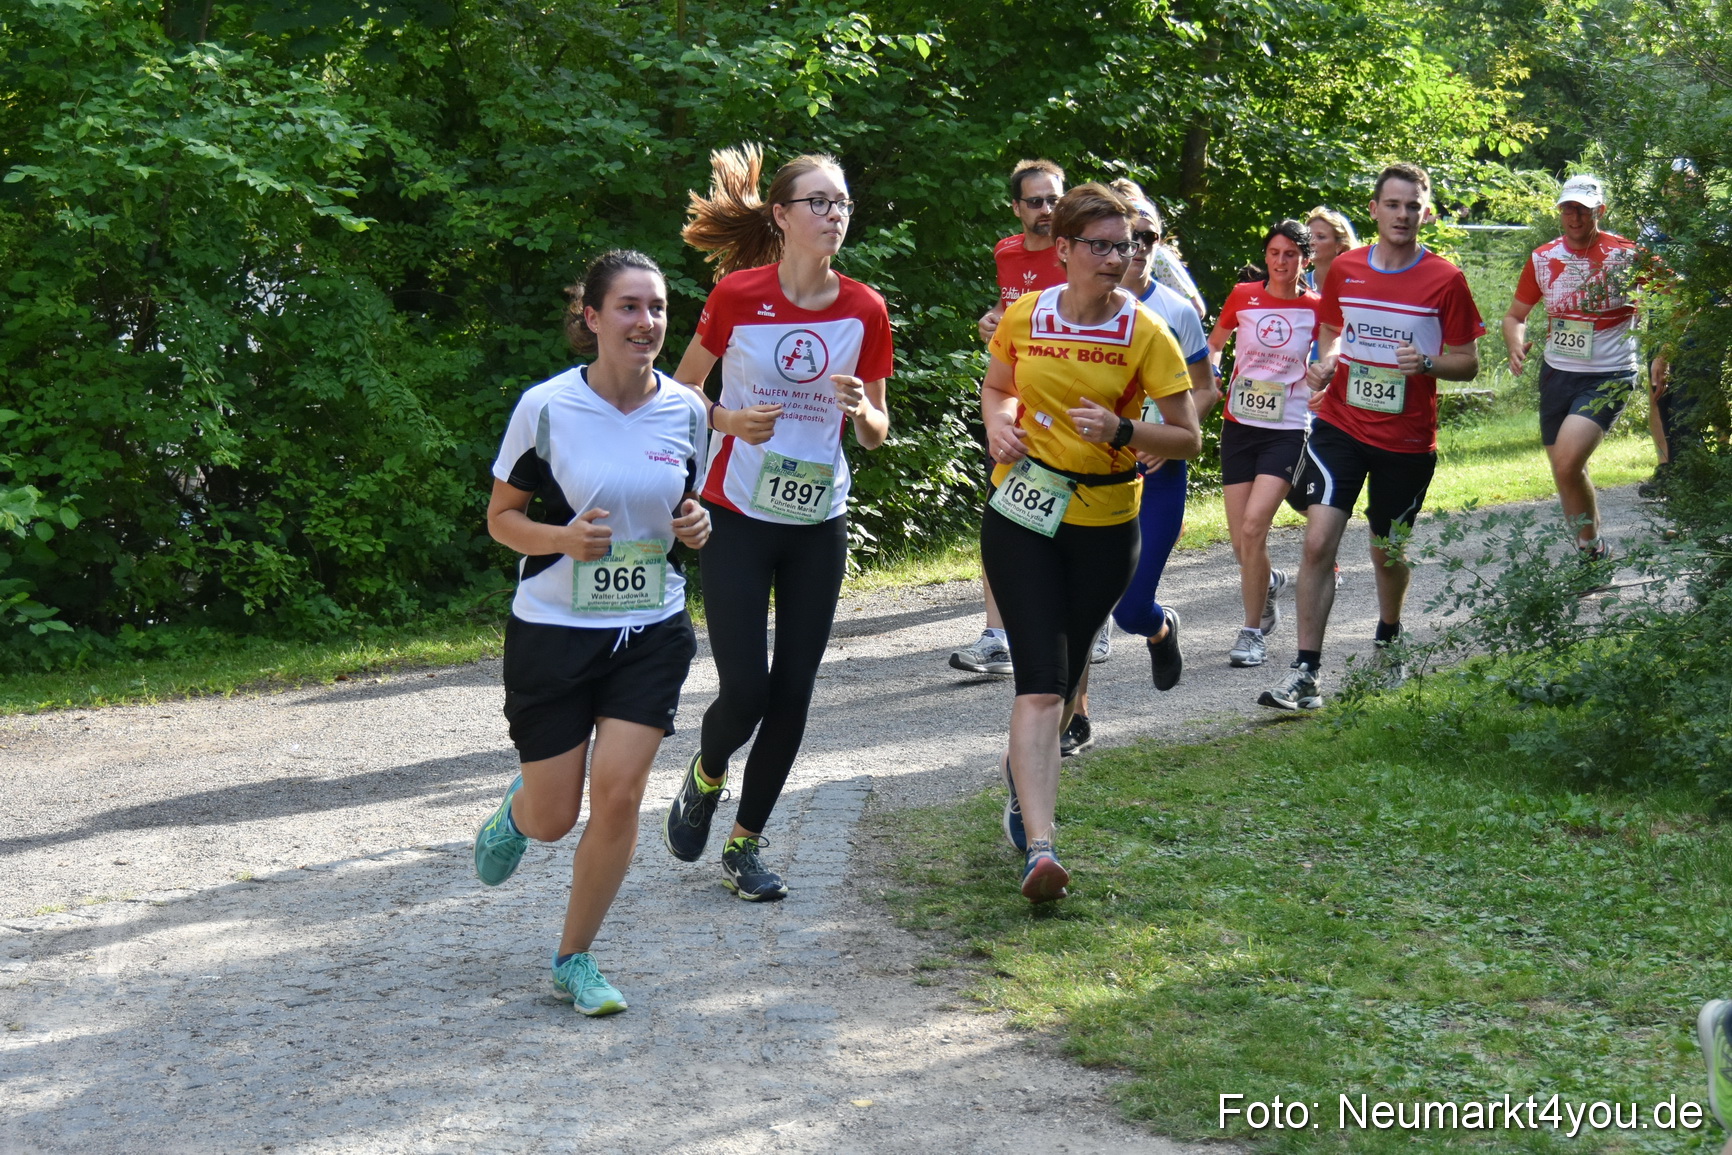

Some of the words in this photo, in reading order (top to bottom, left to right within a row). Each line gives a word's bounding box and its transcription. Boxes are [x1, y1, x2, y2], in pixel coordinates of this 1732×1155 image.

[1358, 322, 1413, 344] Petry
[1554, 331, 1586, 348] 2236
[1028, 345, 1070, 359] MAX
[1077, 347, 1128, 366] BÖGL
[753, 384, 788, 397] LAUFEN
[791, 391, 810, 400] MIT
[1354, 379, 1397, 401] 1834
[792, 402, 802, 410] Dr.
[803, 404, 828, 414] Röschl
[1238, 391, 1277, 411] 1894
[654, 456, 680, 464] partner
[768, 476, 827, 507] 1897
[1004, 476, 1056, 518] 1684
[1026, 511, 1044, 522] Lydia
[594, 566, 646, 592] 966
[616, 592, 649, 600] Ludowika
